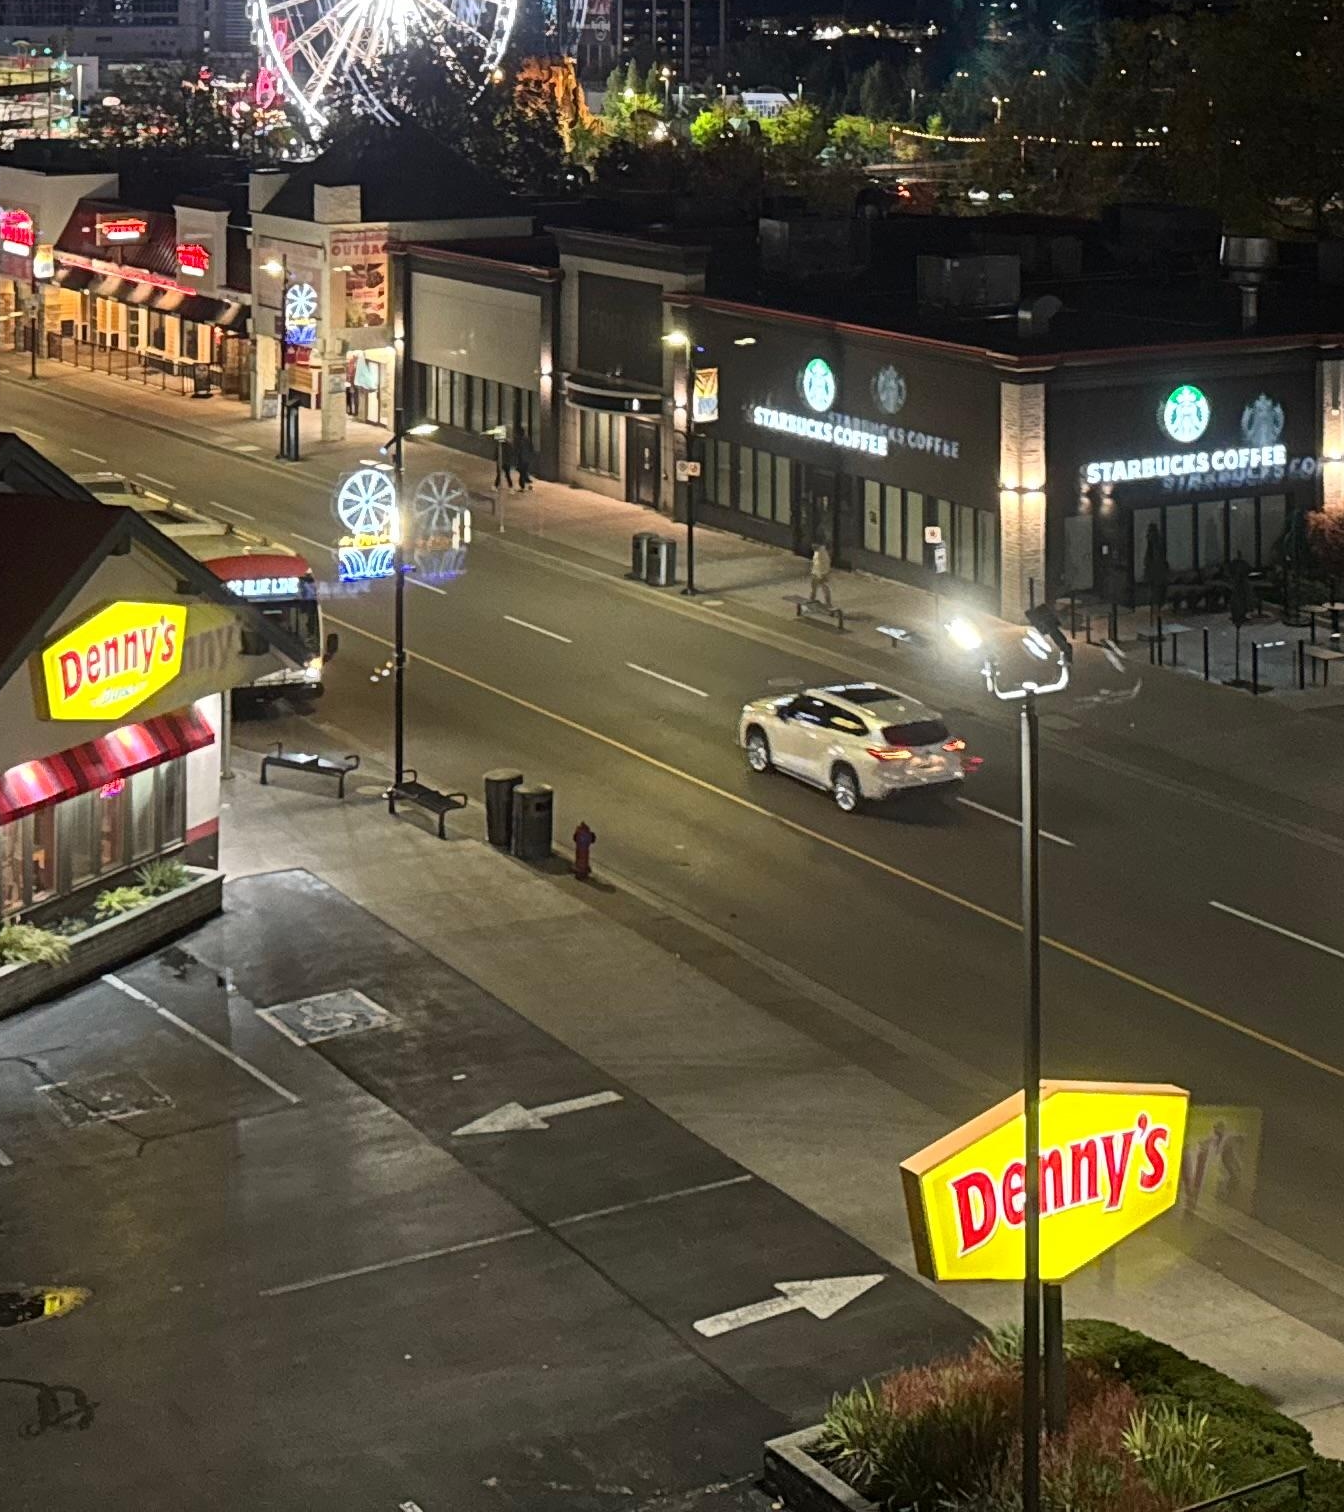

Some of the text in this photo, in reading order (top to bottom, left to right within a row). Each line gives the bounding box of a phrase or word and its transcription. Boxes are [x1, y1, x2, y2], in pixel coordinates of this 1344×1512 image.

[753, 405, 889, 457] STARBUCKS COFFEE
[1086, 452, 1210, 484] STARBUCKS
[1211, 443, 1288, 472] COFFEE
[58, 615, 177, 700] Denny's
[951, 1112, 1169, 1254] Denny's
